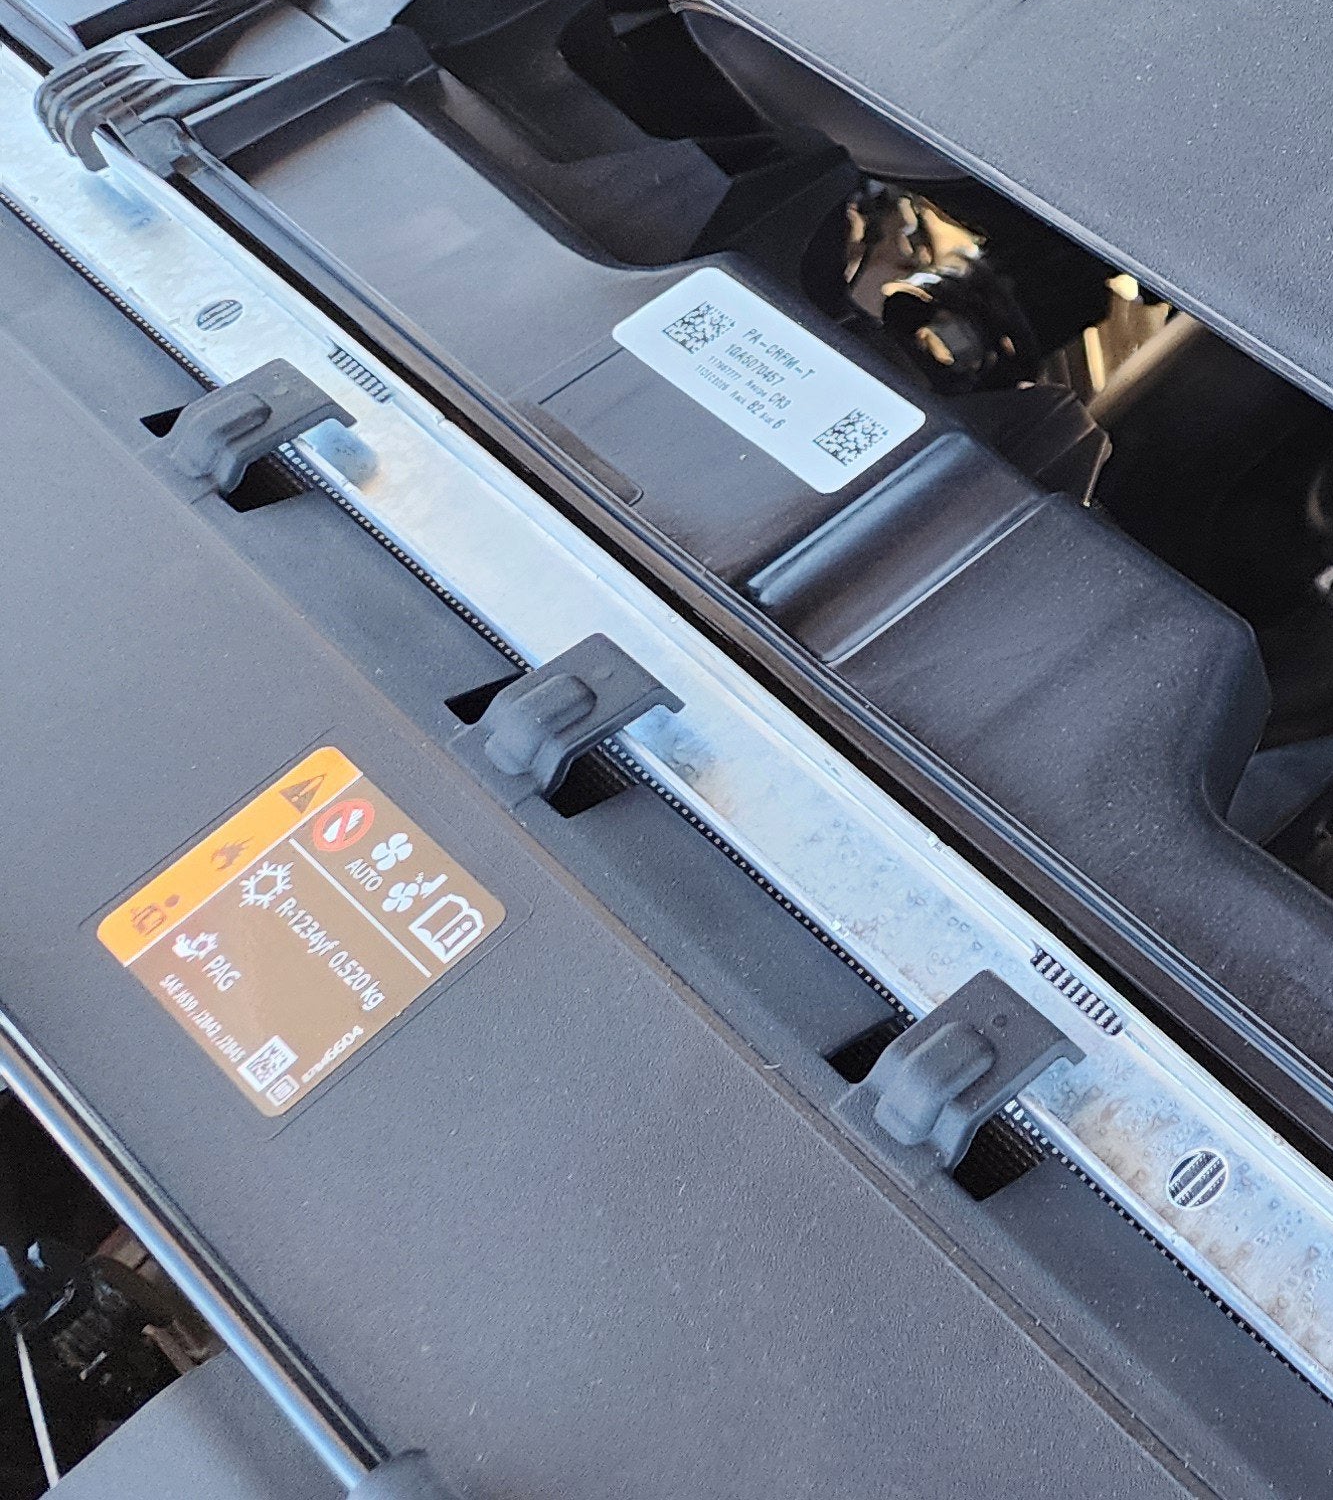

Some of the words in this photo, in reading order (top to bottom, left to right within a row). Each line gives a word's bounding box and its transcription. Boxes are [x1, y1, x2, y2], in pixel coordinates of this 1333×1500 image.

[345, 858, 384, 892] AUTO
[275, 896, 338, 959] R-1234yf
[328, 949, 370, 992] 0.520
[360, 979, 386, 1011] kg
[202, 954, 241, 992] PAG
